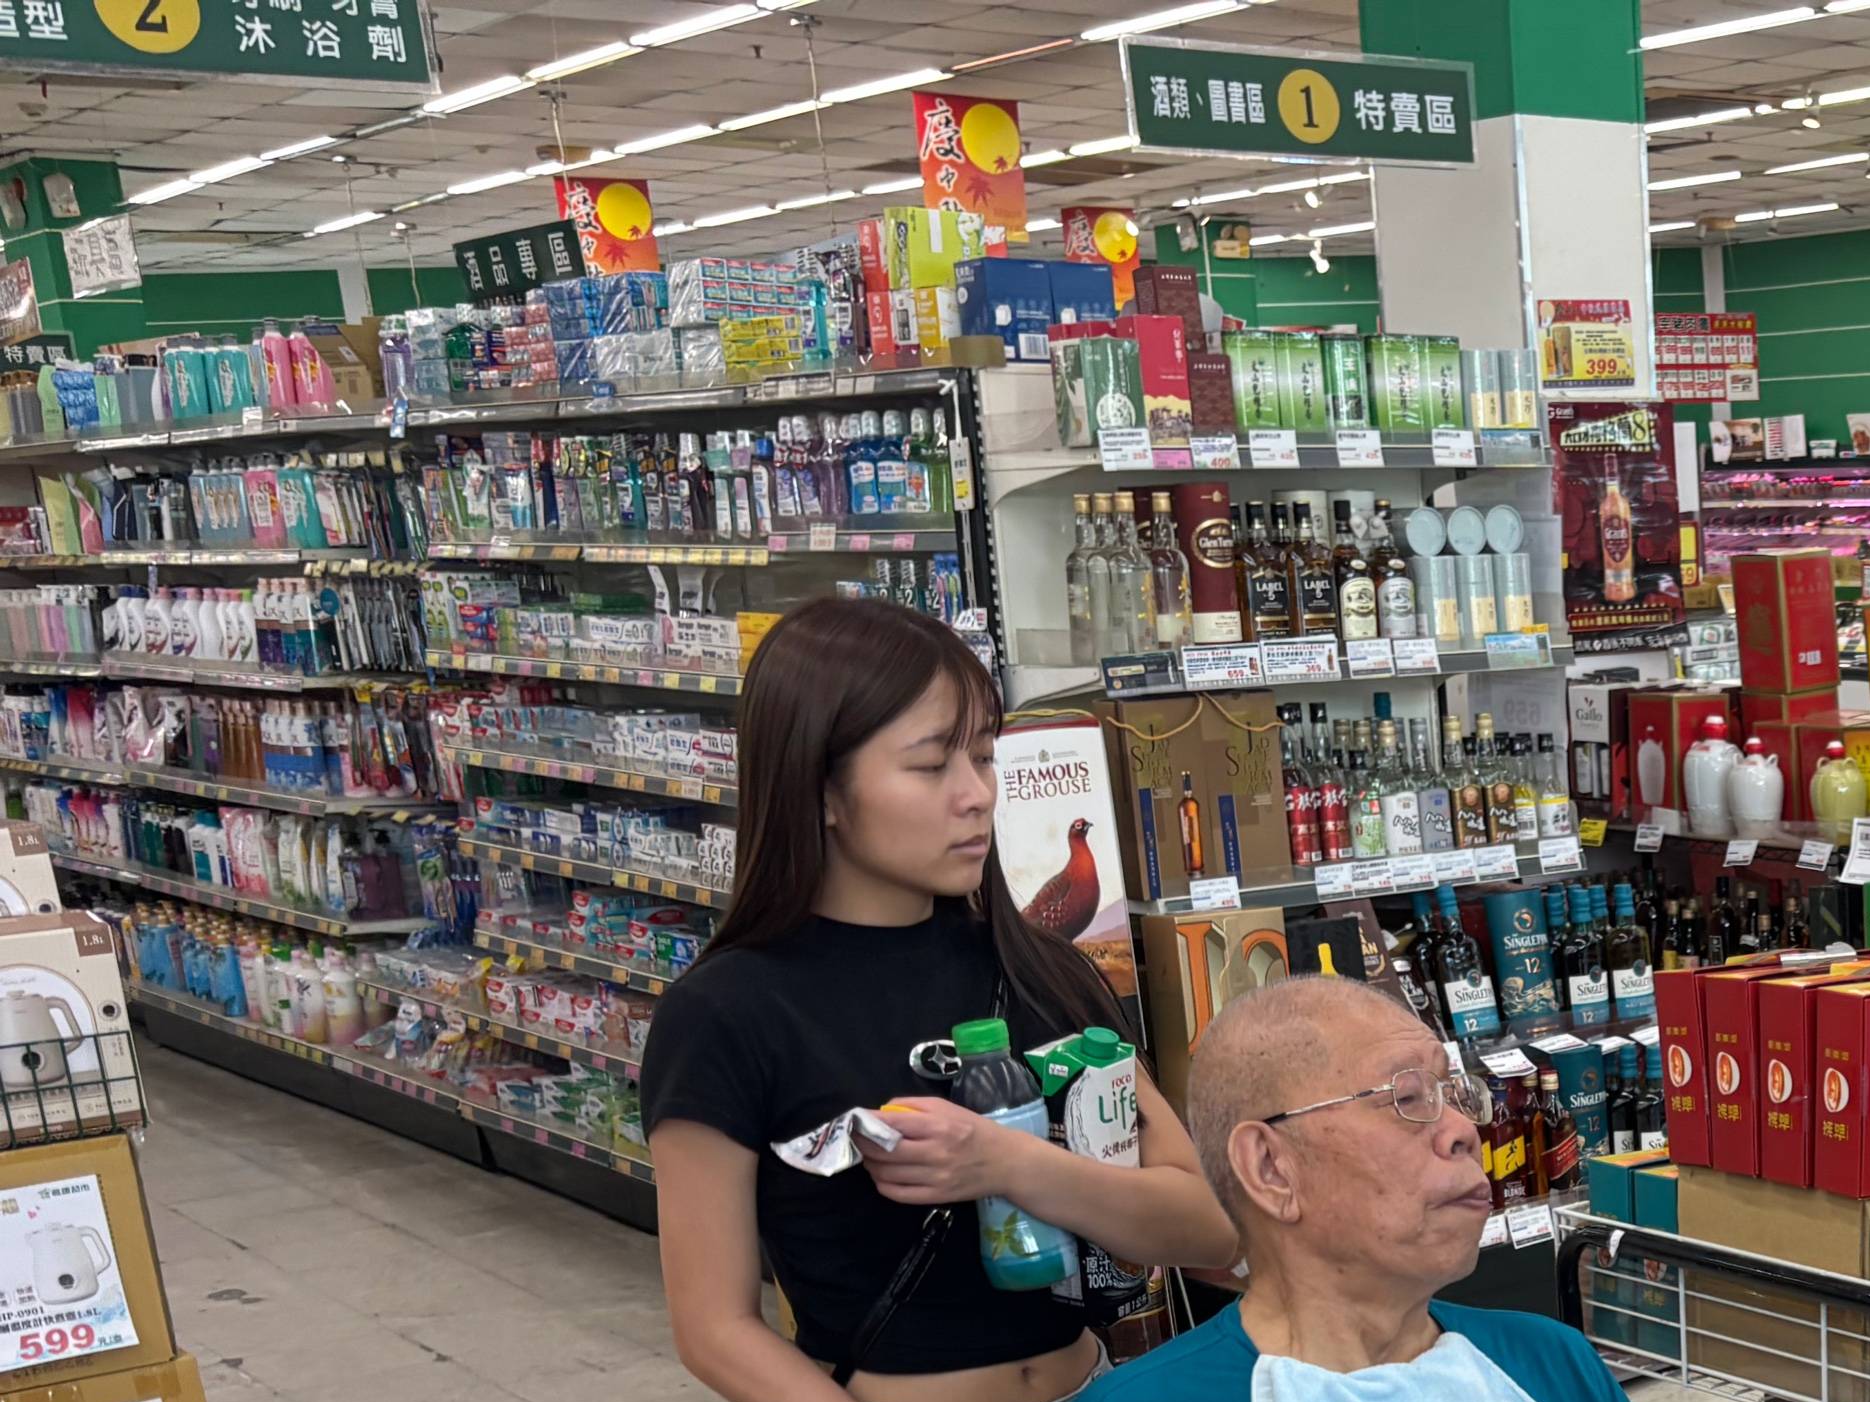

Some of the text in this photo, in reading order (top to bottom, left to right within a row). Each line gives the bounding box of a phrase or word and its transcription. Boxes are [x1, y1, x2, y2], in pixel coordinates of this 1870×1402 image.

[234, 15, 406, 63] 沐浴劑
[1299, 85, 1320, 129] 1
[1353, 89, 1457, 135] 特賣區
[1586, 359, 1617, 375] 399
[1256, 580, 1284, 592] LABEL
[1304, 579, 1331, 591] LABEL
[1016, 761, 1090, 785] FAMOUS
[1004, 770, 1018, 802] THE
[1018, 777, 1092, 801] GROUSE
[1524, 957, 1541, 974] 12
[1464, 1018, 1480, 1033] 12
[1582, 1011, 1594, 1024] 12
[1087, 1273, 1113, 1289] 100%
[19, 1323, 96, 1362] 599
